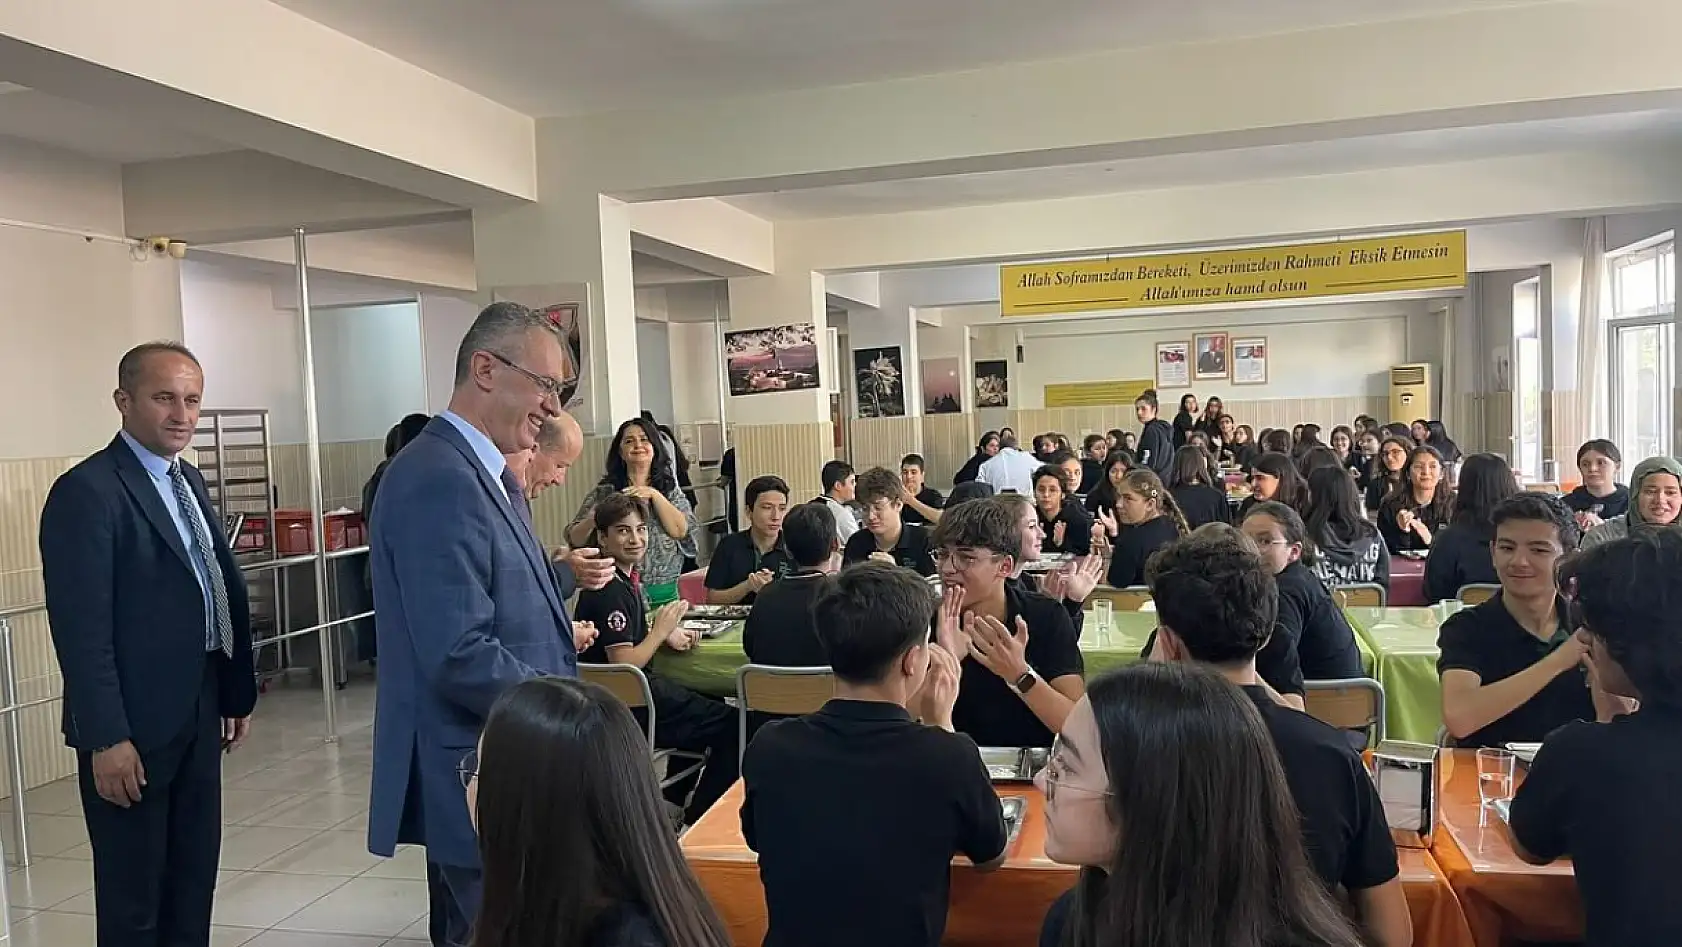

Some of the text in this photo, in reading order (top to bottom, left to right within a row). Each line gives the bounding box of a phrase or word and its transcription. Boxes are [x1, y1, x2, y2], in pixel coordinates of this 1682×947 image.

[1017, 243, 1448, 288] Allah Soframızdan Bereketi, Üzerimizden Rahmeti Eksik Etmesin
[1225, 280, 1266, 296] hamd
[1268, 278, 1308, 293] olsun
